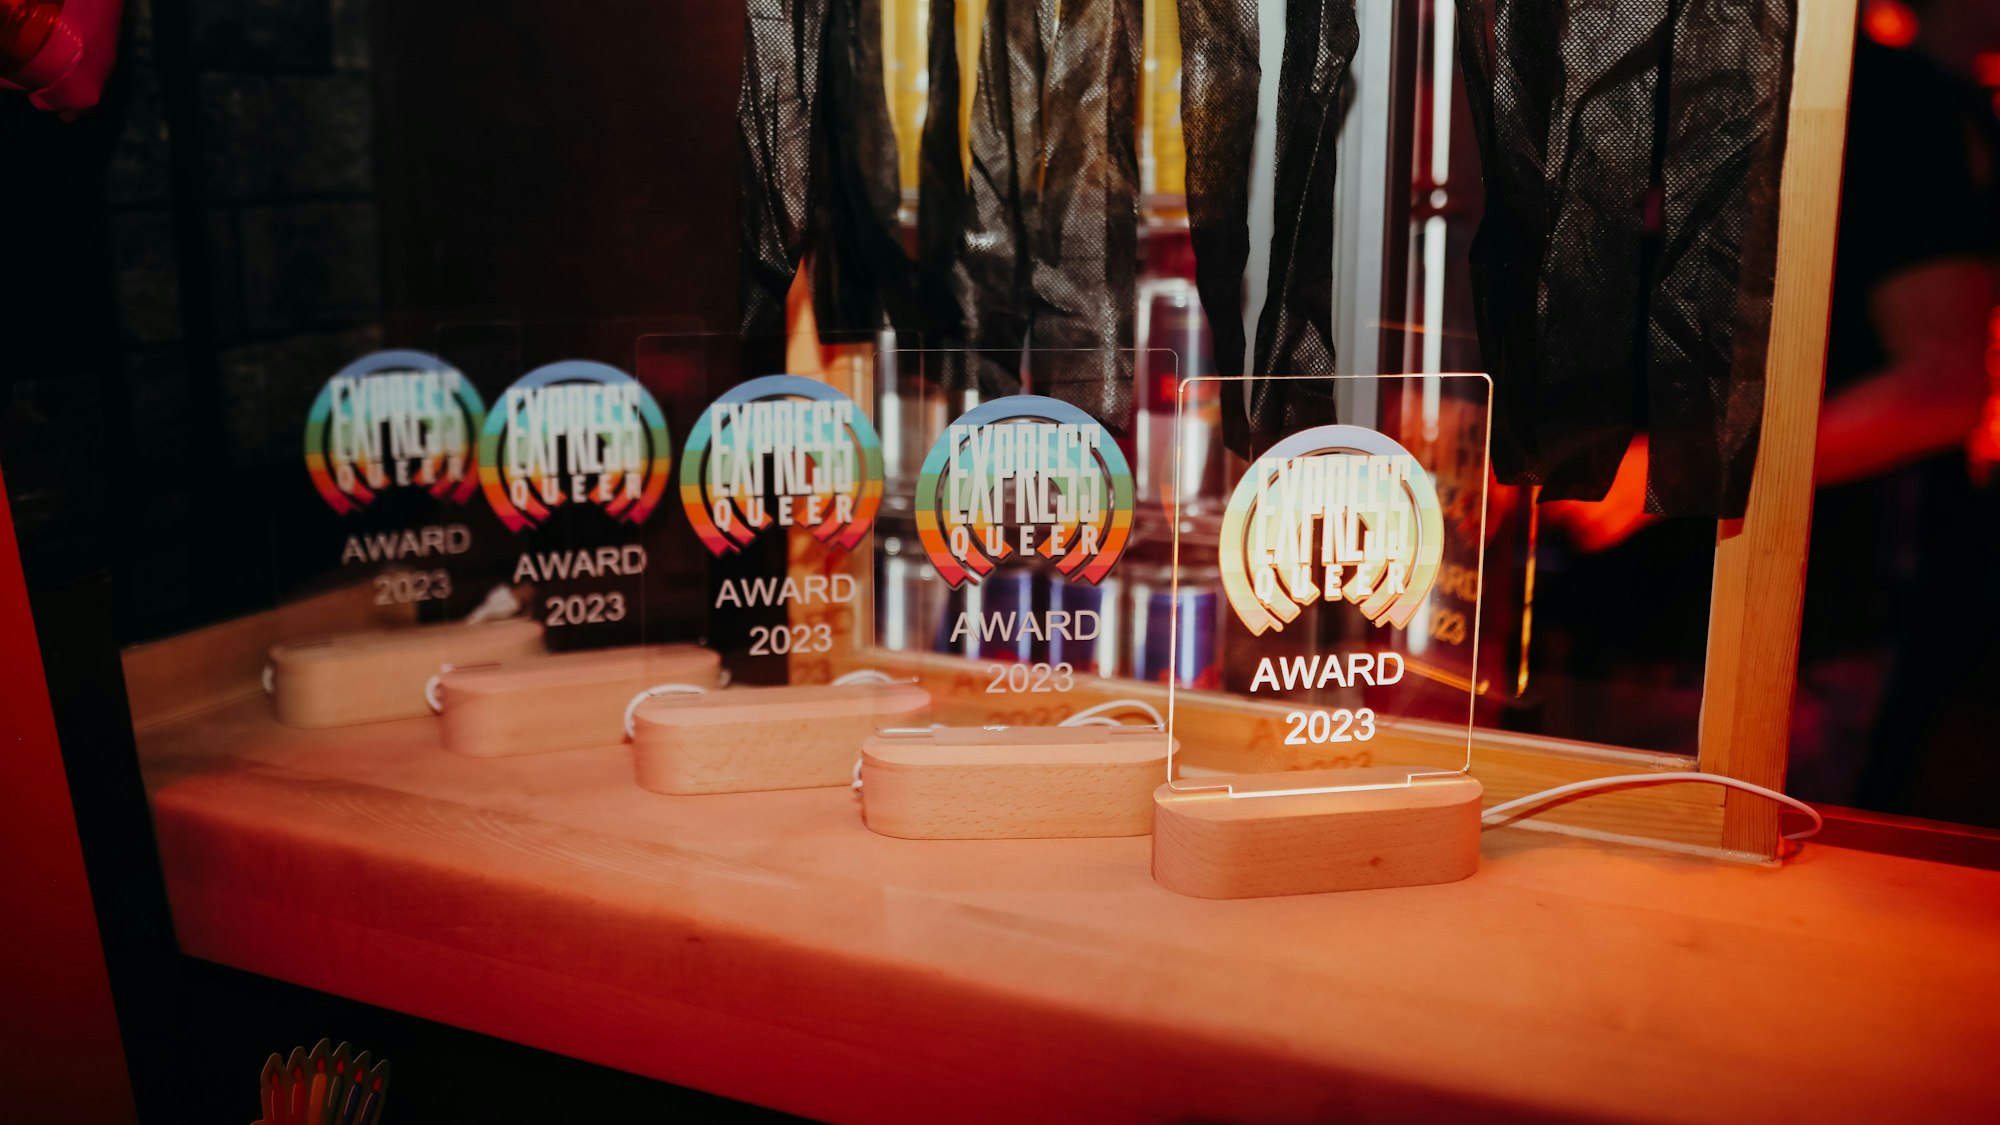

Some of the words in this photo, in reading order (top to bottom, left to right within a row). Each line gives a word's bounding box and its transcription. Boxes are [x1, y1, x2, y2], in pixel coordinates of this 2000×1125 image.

[330, 369, 463, 460] EXPRESS
[506, 383, 641, 477] EXPRESS
[710, 400, 854, 497] EXPRESS
[510, 474, 642, 509] QUEER
[949, 423, 1101, 526] EXPRESS
[713, 494, 854, 531] QUEER
[1256, 455, 1411, 566] EXPRESS
[342, 524, 471, 564] AWARD
[950, 525, 1099, 562] QUEER
[513, 545, 647, 584] AWARD
[373, 571, 452, 606] 2023
[714, 574, 856, 609] AWARD
[1254, 564, 1405, 603] QUEER
[546, 592, 626, 627] 2023
[950, 610, 1101, 643] AWARD
[748, 624, 833, 657] 2023
[986, 662, 1074, 695] 2023
[1250, 652, 1405, 693] AWARD
[1284, 709, 1376, 746] 2023
